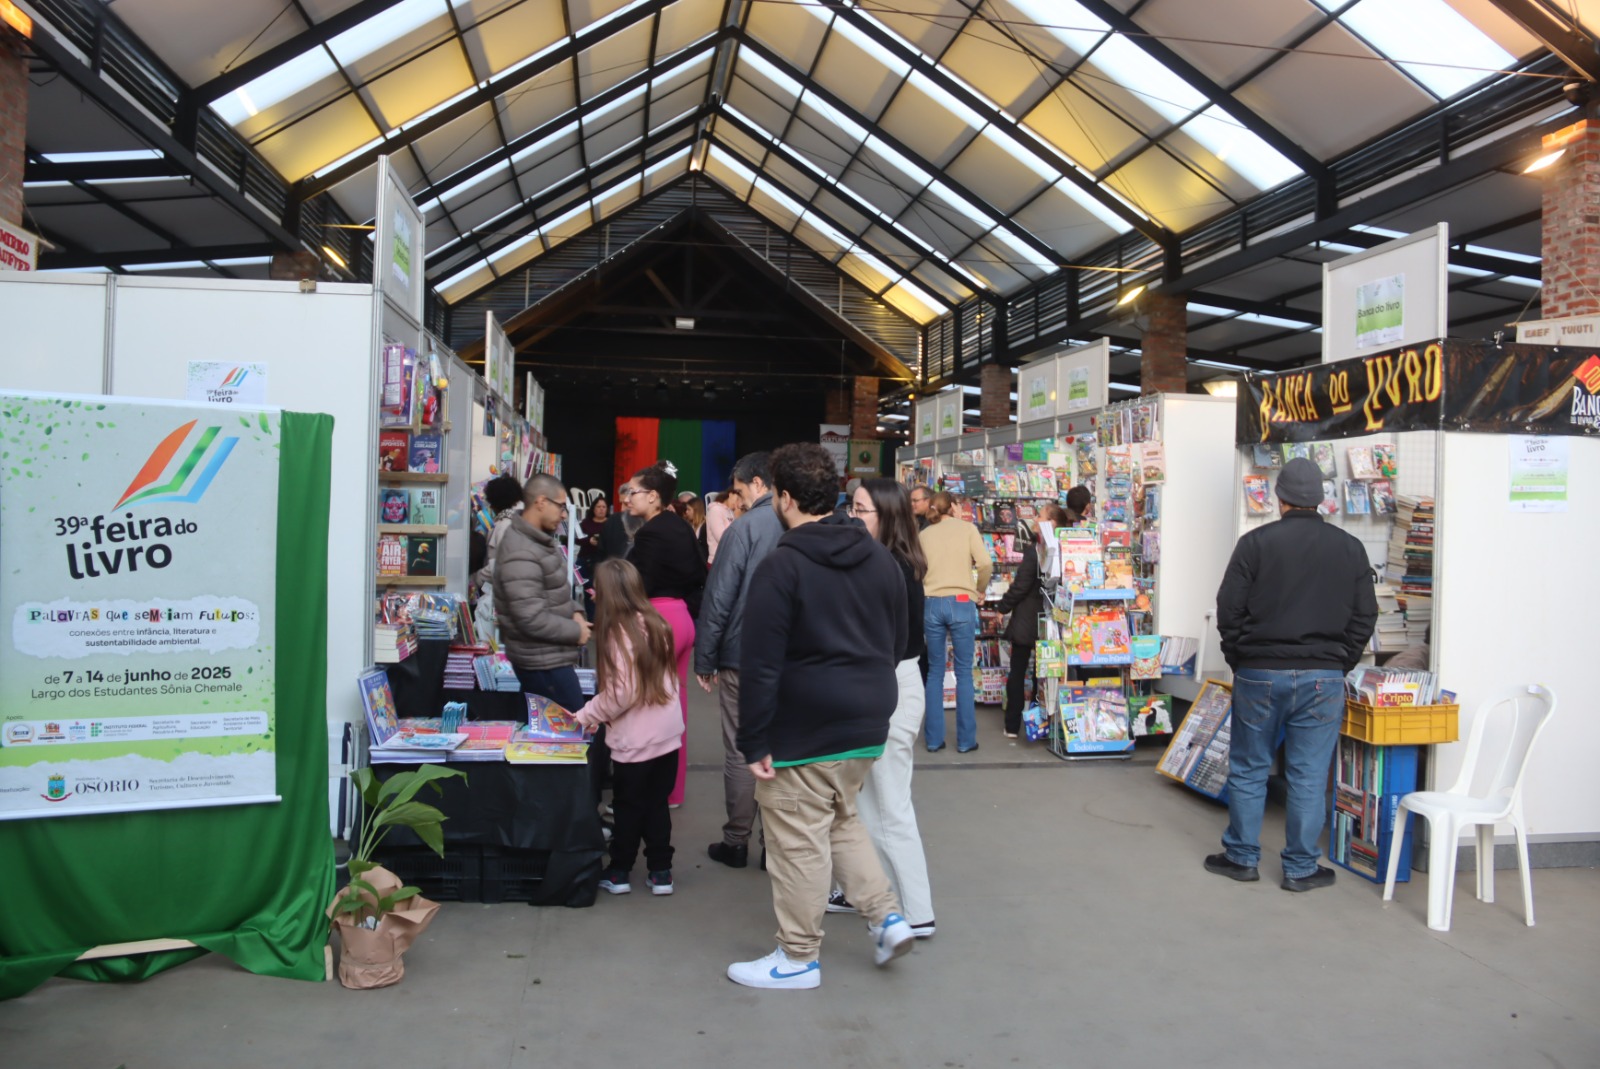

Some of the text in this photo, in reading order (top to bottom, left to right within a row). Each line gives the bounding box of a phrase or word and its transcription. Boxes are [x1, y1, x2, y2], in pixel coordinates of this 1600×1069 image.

[1358, 301, 1400, 318] Banca do livro
[1259, 344, 1442, 442] BANCA DO LIVRO
[90, 512, 172, 544] feira
[174, 519, 198, 535] do
[382, 545, 401, 556] AIR
[66, 541, 173, 580] livro
[382, 557, 401, 565] FRYER
[106, 610, 128, 621] que
[136, 628, 171, 636] infância,
[1042, 646, 1056, 658] 101
[44, 666, 231, 685] de 7 a 14 de junho de 2025
[31, 682, 242, 700] Largo dos Estudantes Sônia Chemale
[1383, 693, 1412, 705] Cripto
[75, 779, 139, 794] OSÓRIO
